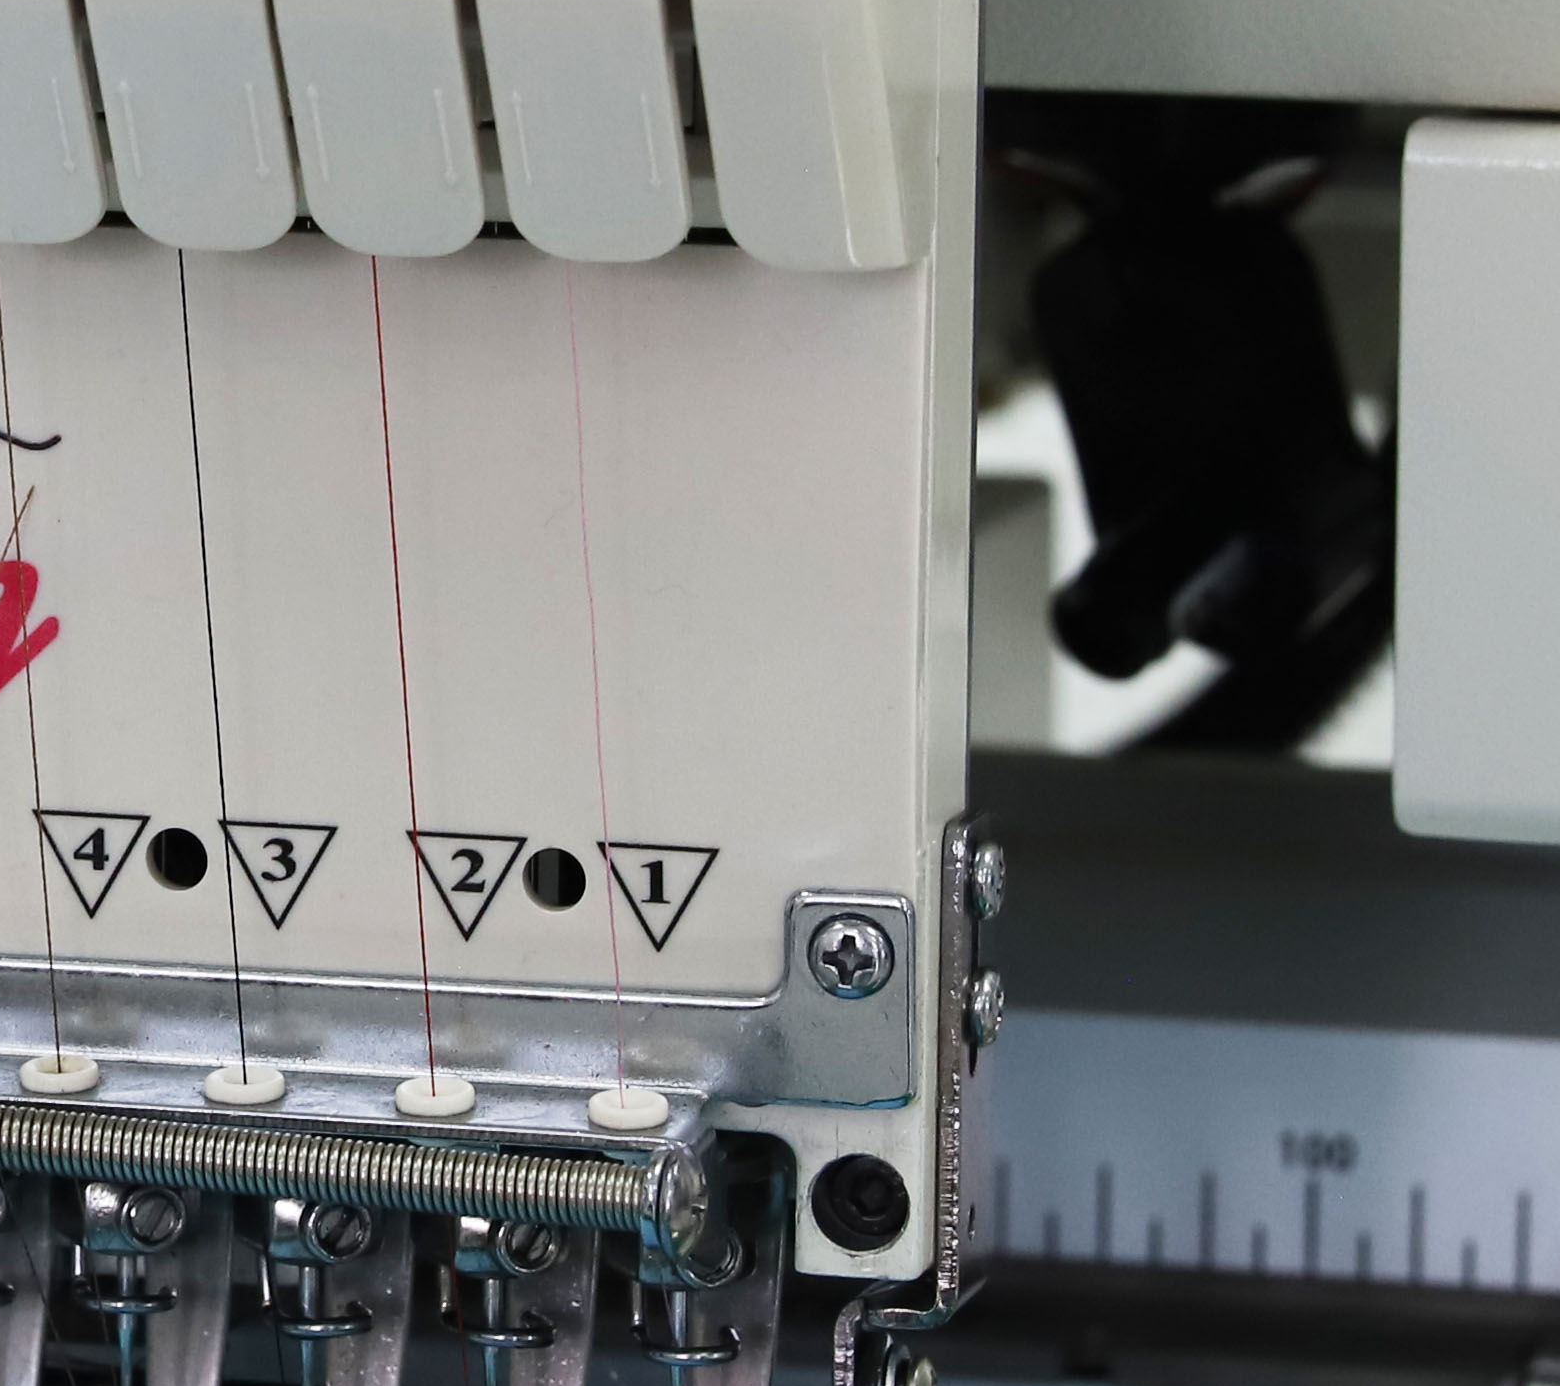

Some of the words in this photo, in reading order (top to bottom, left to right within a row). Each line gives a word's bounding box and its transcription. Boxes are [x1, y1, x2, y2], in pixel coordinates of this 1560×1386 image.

[72, 826, 111, 872] 4
[259, 836, 298, 883] 3
[449, 847, 487, 894] 2
[639, 859, 672, 906] 1
[1278, 1130, 1359, 1171] 100
